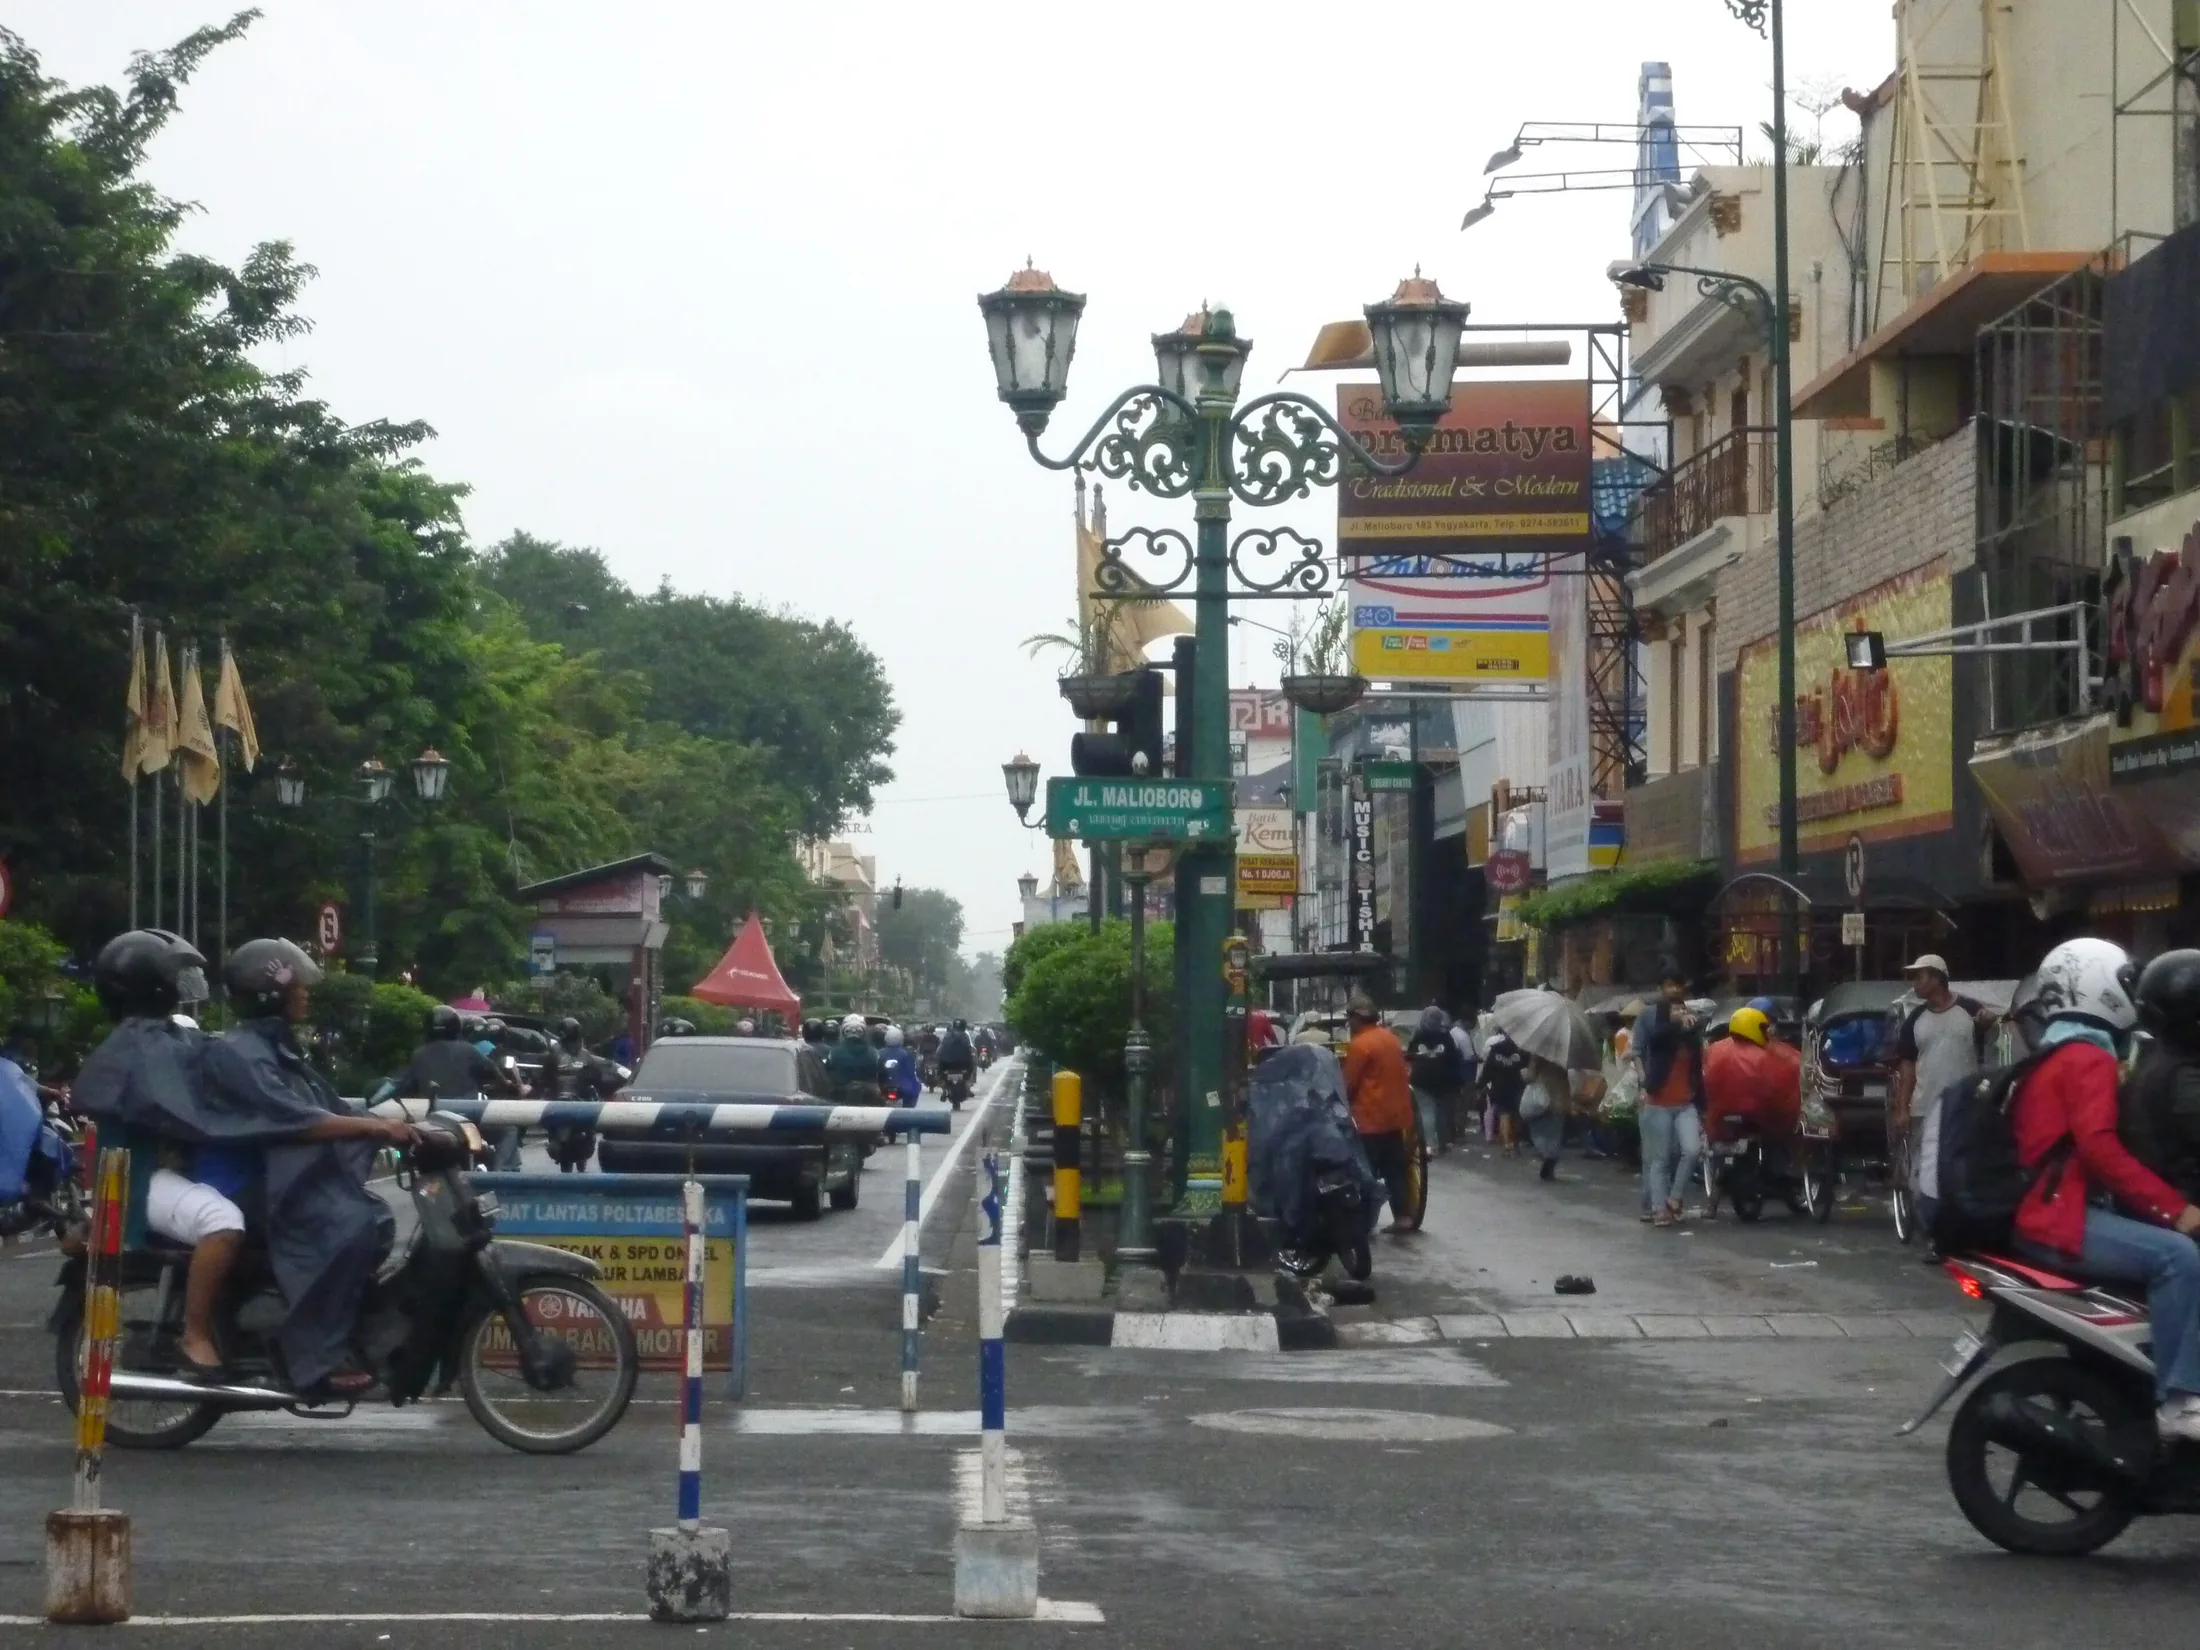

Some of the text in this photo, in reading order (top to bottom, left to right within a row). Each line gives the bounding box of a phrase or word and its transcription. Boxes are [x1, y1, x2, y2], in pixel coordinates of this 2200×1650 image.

[1349, 420, 1579, 462] prmatya
[1350, 475, 1580, 498] Tradisional & Modern
[1359, 608, 1373, 619] 24
[1073, 786, 1202, 809] JL. MALIOBORO
[1353, 801, 1371, 862] MUSIC
[1242, 869, 1291, 880] No. 1 DJOGJA
[535, 1203, 598, 1222] LANTAS
[609, 1245, 621, 1260] &
[627, 1246, 659, 1260] SPD
[567, 1297, 647, 1320] YAHA
[637, 1330, 719, 1355] MOTR
